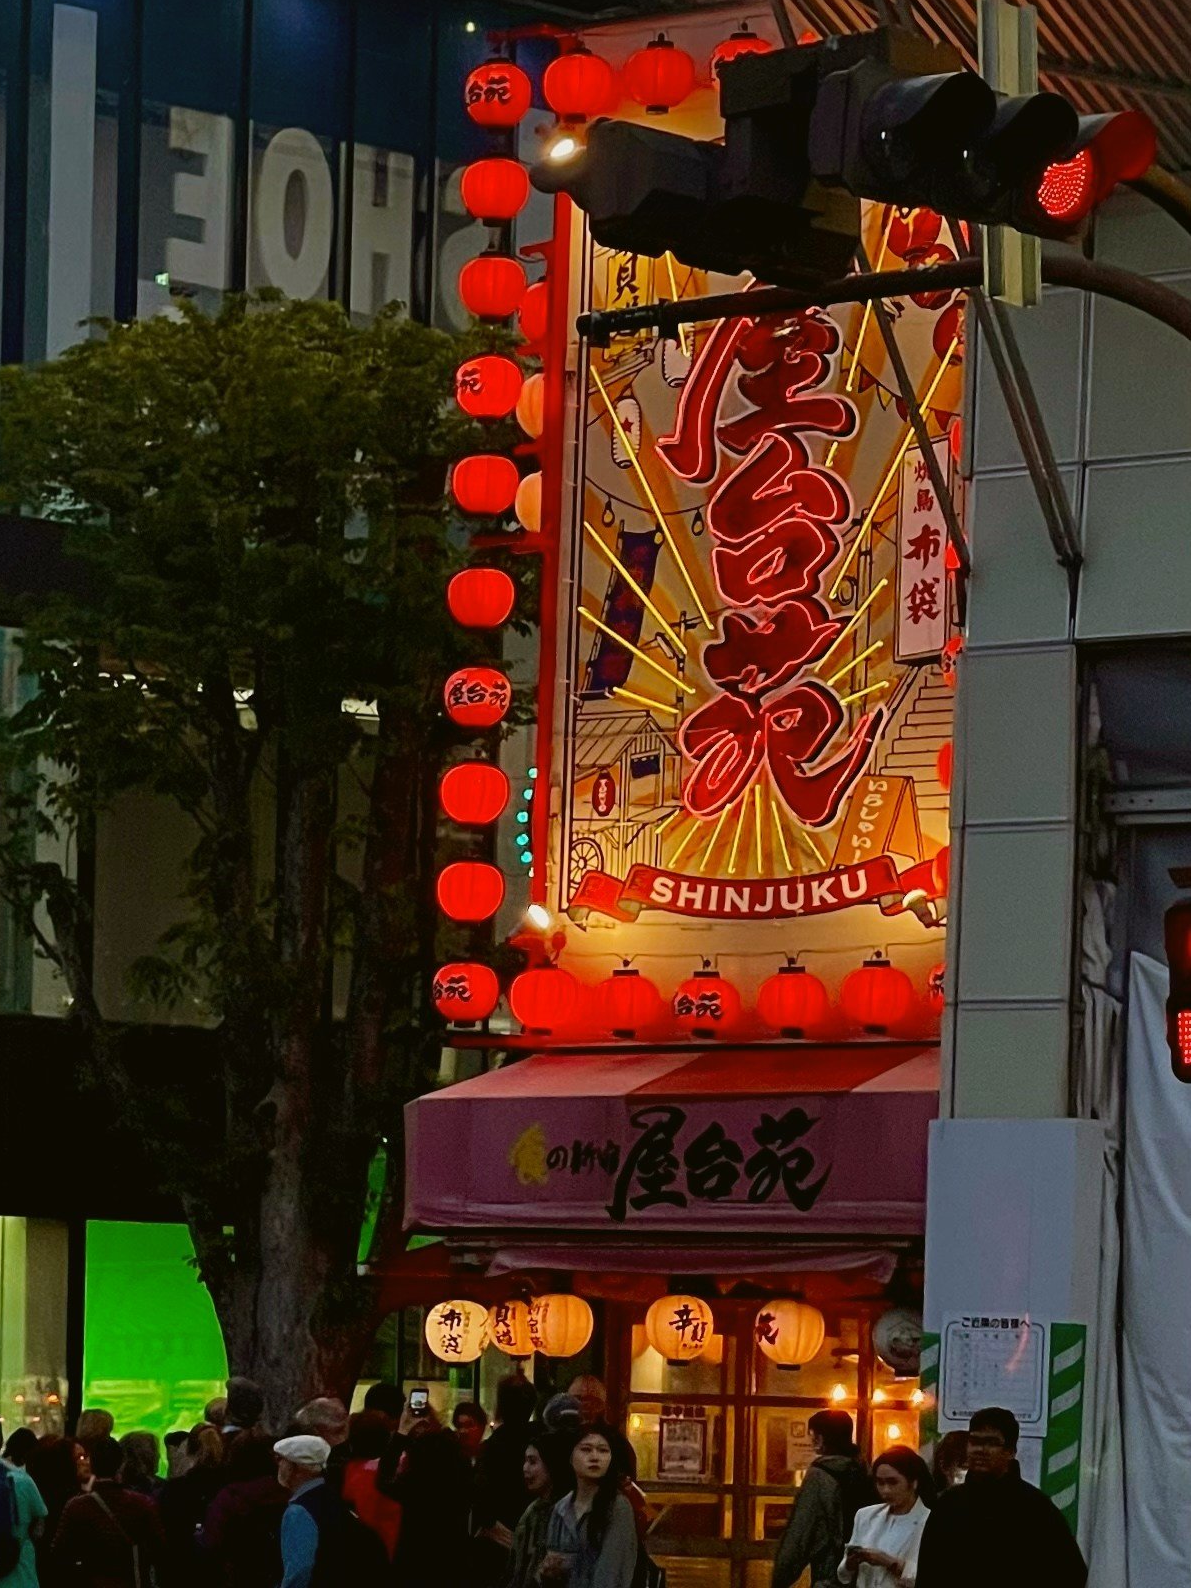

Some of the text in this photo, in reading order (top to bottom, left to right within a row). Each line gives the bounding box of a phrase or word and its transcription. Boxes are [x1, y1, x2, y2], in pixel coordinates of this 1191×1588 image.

[649, 869, 868, 914] SHINJUKU
[604, 1106, 833, 1224] 屋台苑
